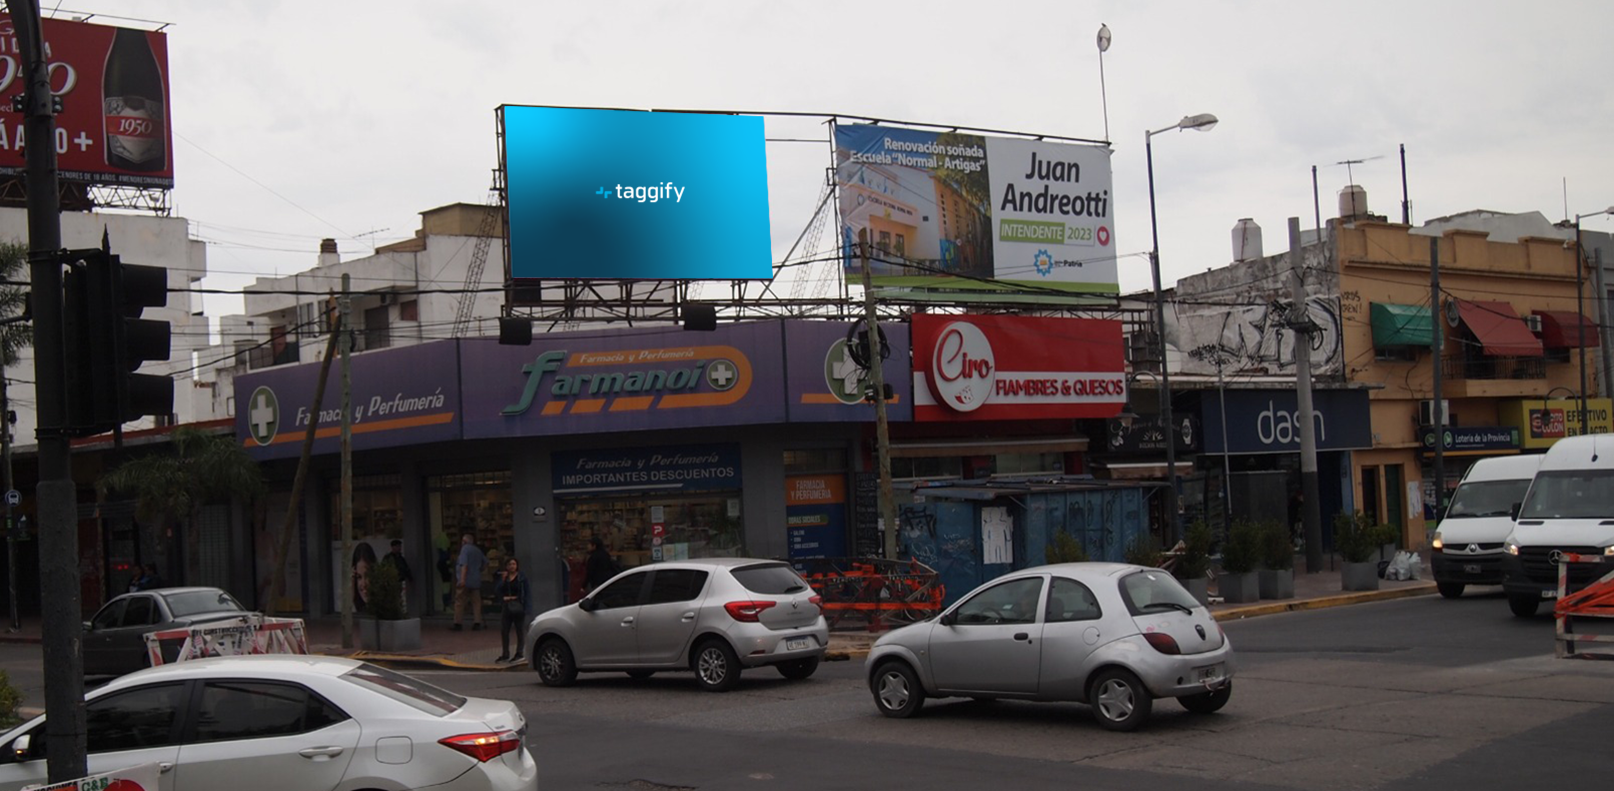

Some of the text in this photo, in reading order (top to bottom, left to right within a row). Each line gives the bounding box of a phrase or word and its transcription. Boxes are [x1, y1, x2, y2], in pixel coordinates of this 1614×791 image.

[118, 118, 153, 135] 1950
[884, 137, 984, 158] Renovación soñada
[850, 151, 892, 165] Escuela
[1025, 152, 1080, 183] Juan
[615, 182, 685, 203] taggify
[1001, 183, 1108, 218] Andreotti
[1001, 223, 1092, 241] INTENDENTE 2023
[628, 355, 636, 364] y
[936, 328, 993, 383] Ciro
[995, 379, 1124, 397] FIAMBRES & QUESOS
[295, 387, 445, 427] Famac y Perfumería
[1566, 409, 1608, 423] EFETIVO
[1474, 433, 1482, 443] de
[1488, 433, 1511, 443] Provincia
[637, 458, 646, 470] y
[651, 452, 719, 466] Perfumería
[562, 467, 735, 485] IMPORTANTES DESCUENTOS
